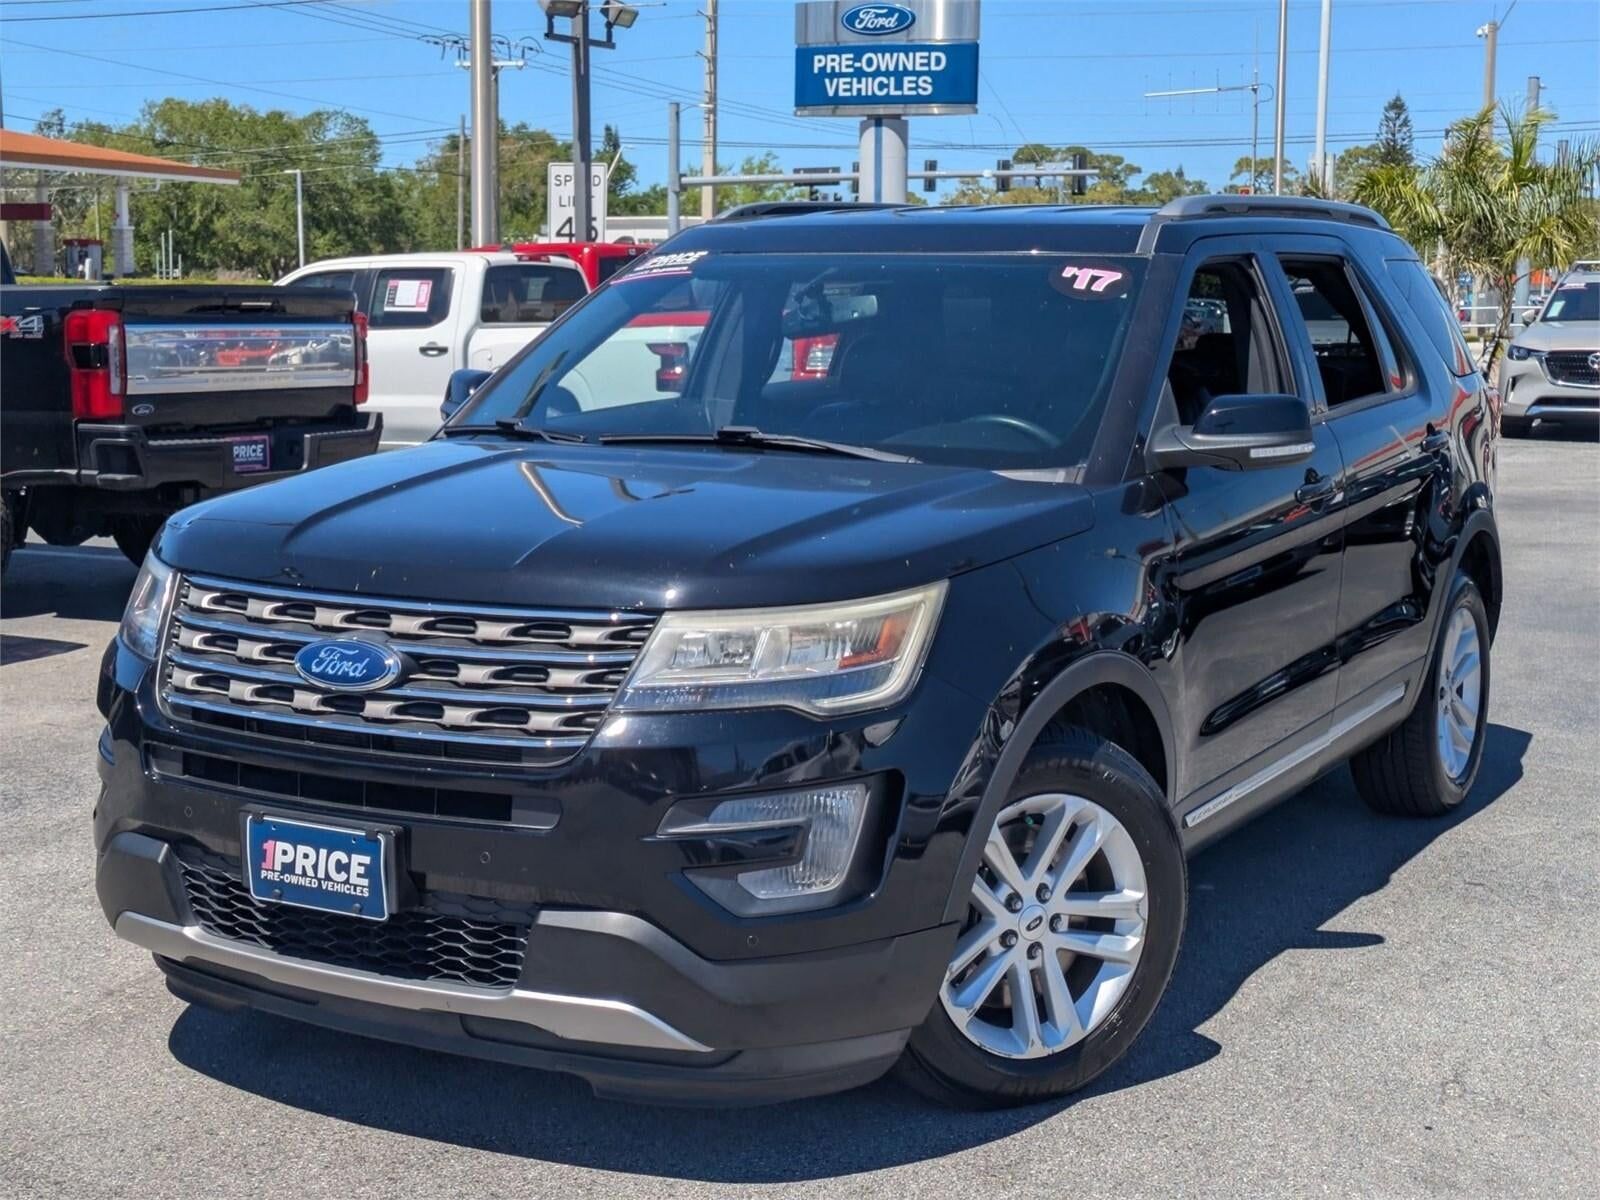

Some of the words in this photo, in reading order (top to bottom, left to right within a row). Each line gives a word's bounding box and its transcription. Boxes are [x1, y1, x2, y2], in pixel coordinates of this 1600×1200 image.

[854, 8, 899, 30] Ford
[813, 52, 947, 74] PRE-OWNED
[824, 76, 934, 97] VEHICLES
[554, 174, 602, 187] SPD
[233, 444, 265, 458] PRICE
[311, 646, 371, 678] Ford
[261, 840, 371, 887] 1PRICE
[260, 869, 319, 888] PRE-OWNED
[320, 880, 370, 898] VEHICLES
